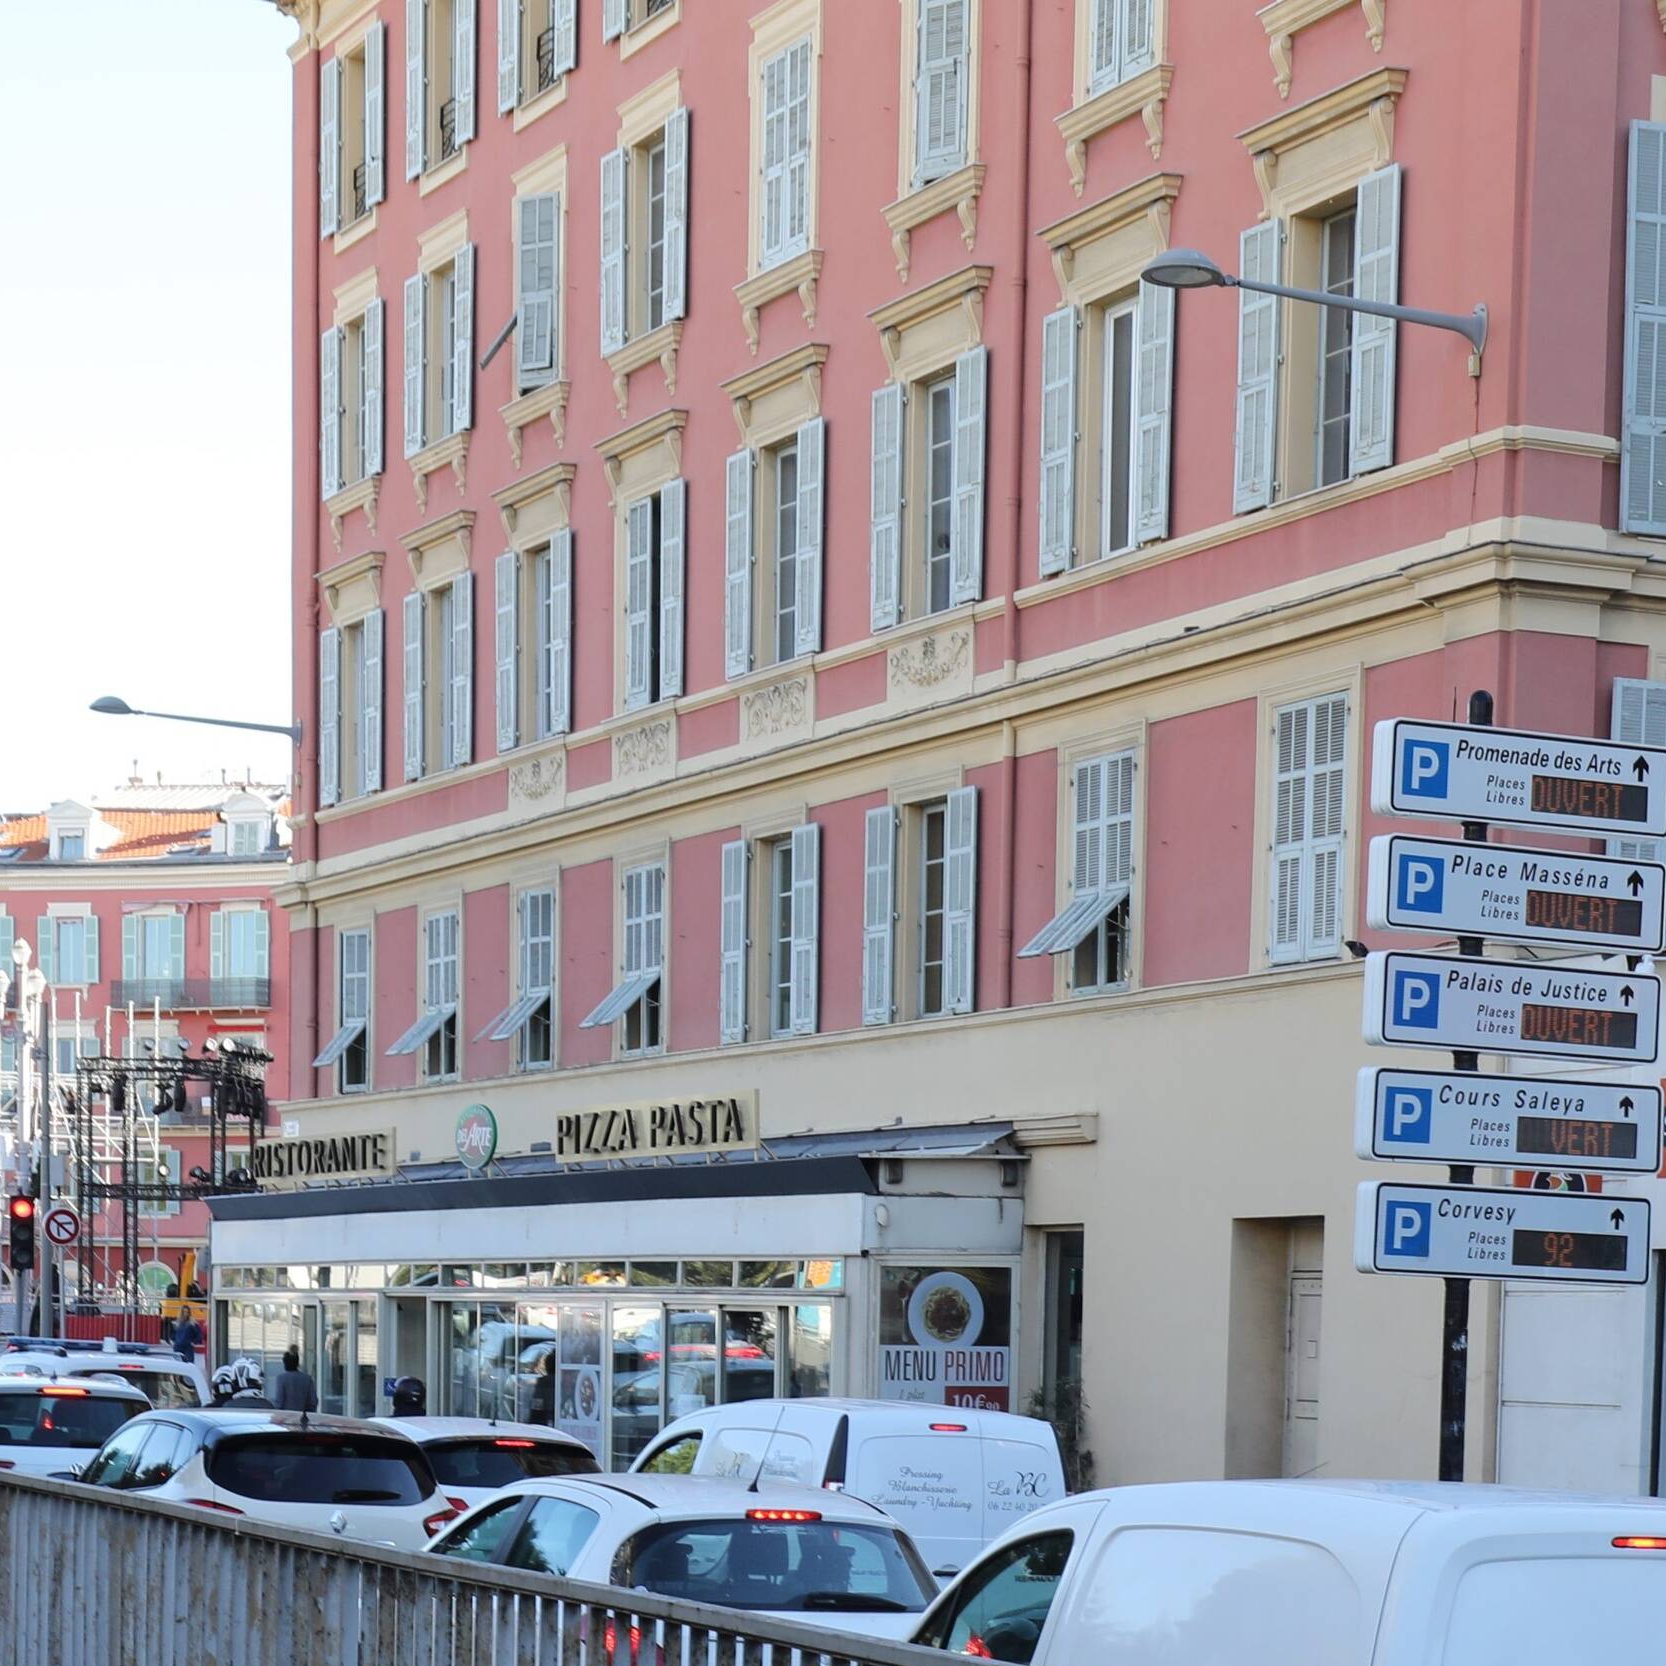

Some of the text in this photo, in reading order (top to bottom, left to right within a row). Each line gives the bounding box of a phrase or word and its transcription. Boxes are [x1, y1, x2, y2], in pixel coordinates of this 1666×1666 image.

[1456, 739, 1550, 769] Promenade
[1553, 752, 1582, 772] des
[1586, 753, 1622, 776] Arts
[1487, 775, 1525, 790] Places
[1486, 790, 1525, 806] Libres
[1533, 776, 1623, 819] OUVERT
[1451, 854, 1508, 879] Place
[1520, 862, 1610, 889] Masséna
[1481, 890, 1520, 905] Places
[1480, 905, 1520, 921] Libres
[1527, 891, 1618, 934] OUVERT
[1446, 969, 1503, 994] Palais
[1511, 976, 1533, 996] de
[1541, 978, 1608, 1002] Justice
[1477, 1004, 1516, 1020] Places
[1476, 1020, 1515, 1035] Libres
[1522, 1005, 1614, 1046] OUVERT
[1439, 1084, 1500, 1108] Cours
[1514, 1089, 1585, 1116] Saleya
[557, 1098, 744, 1155] PIZZA PASTA
[1470, 1118, 1510, 1133] Places
[1470, 1134, 1510, 1148] Libres
[255, 1133, 386, 1178] RISTORANTE
[1438, 1198, 1517, 1225] Corvesy
[1468, 1232, 1507, 1246] Places
[1467, 1247, 1506, 1262] Libres
[1543, 1232, 1575, 1268] 92
[885, 1350, 1004, 1382] MENU PRIMO
[899, 1466, 943, 1482] Pressing
[888, 1480, 958, 1494] Blanchisserie
